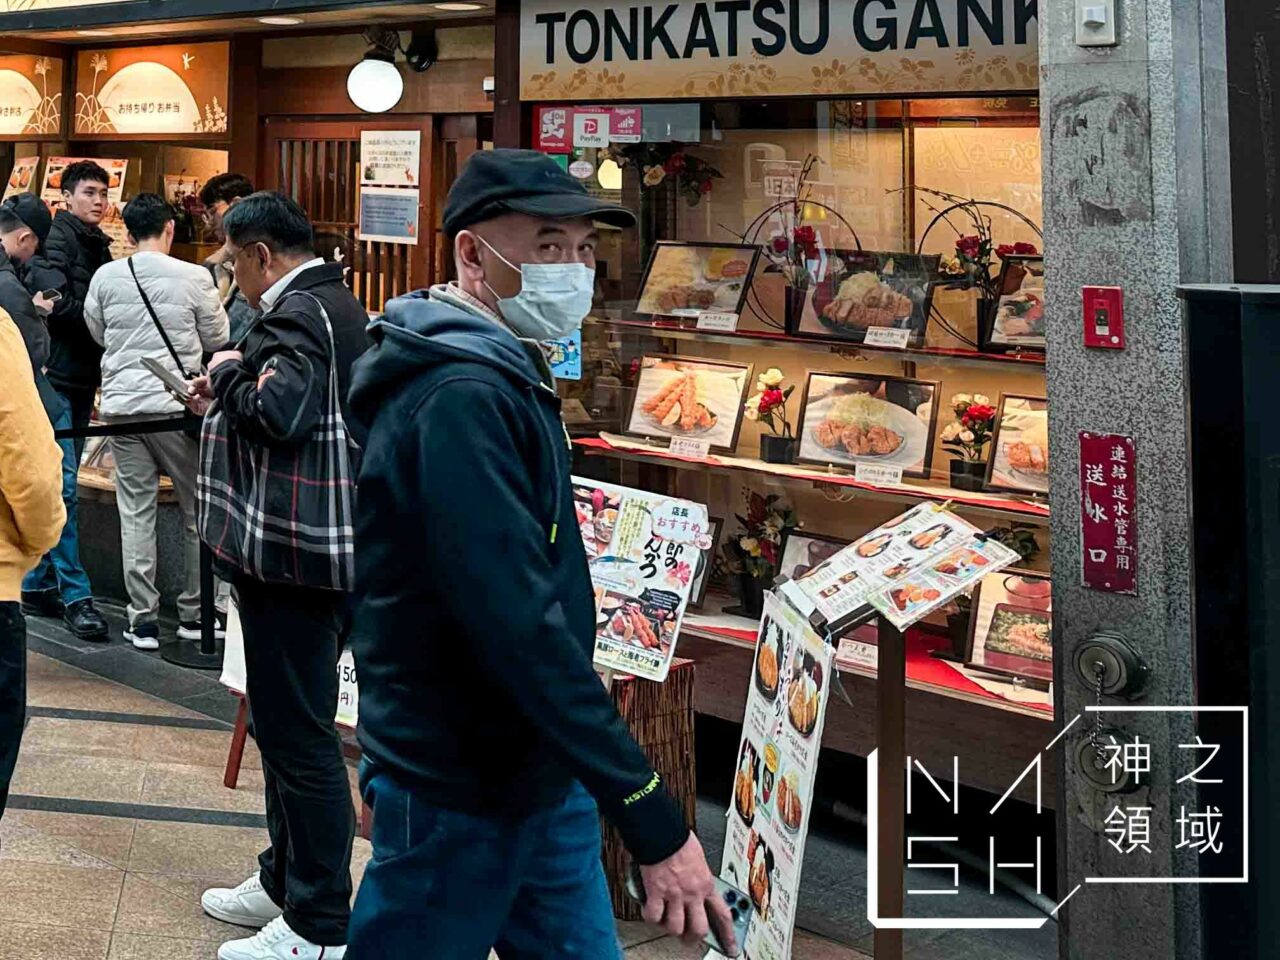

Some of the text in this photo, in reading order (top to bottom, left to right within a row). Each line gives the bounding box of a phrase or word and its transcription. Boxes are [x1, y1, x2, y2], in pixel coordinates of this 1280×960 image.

[580, 134, 602, 143] PayPay
[671, 506, 689, 518] 店長
[1084, 463, 1108, 564] 送水口
[656, 517, 702, 534] おすすめ
[639, 534, 664, 579] んかつ
